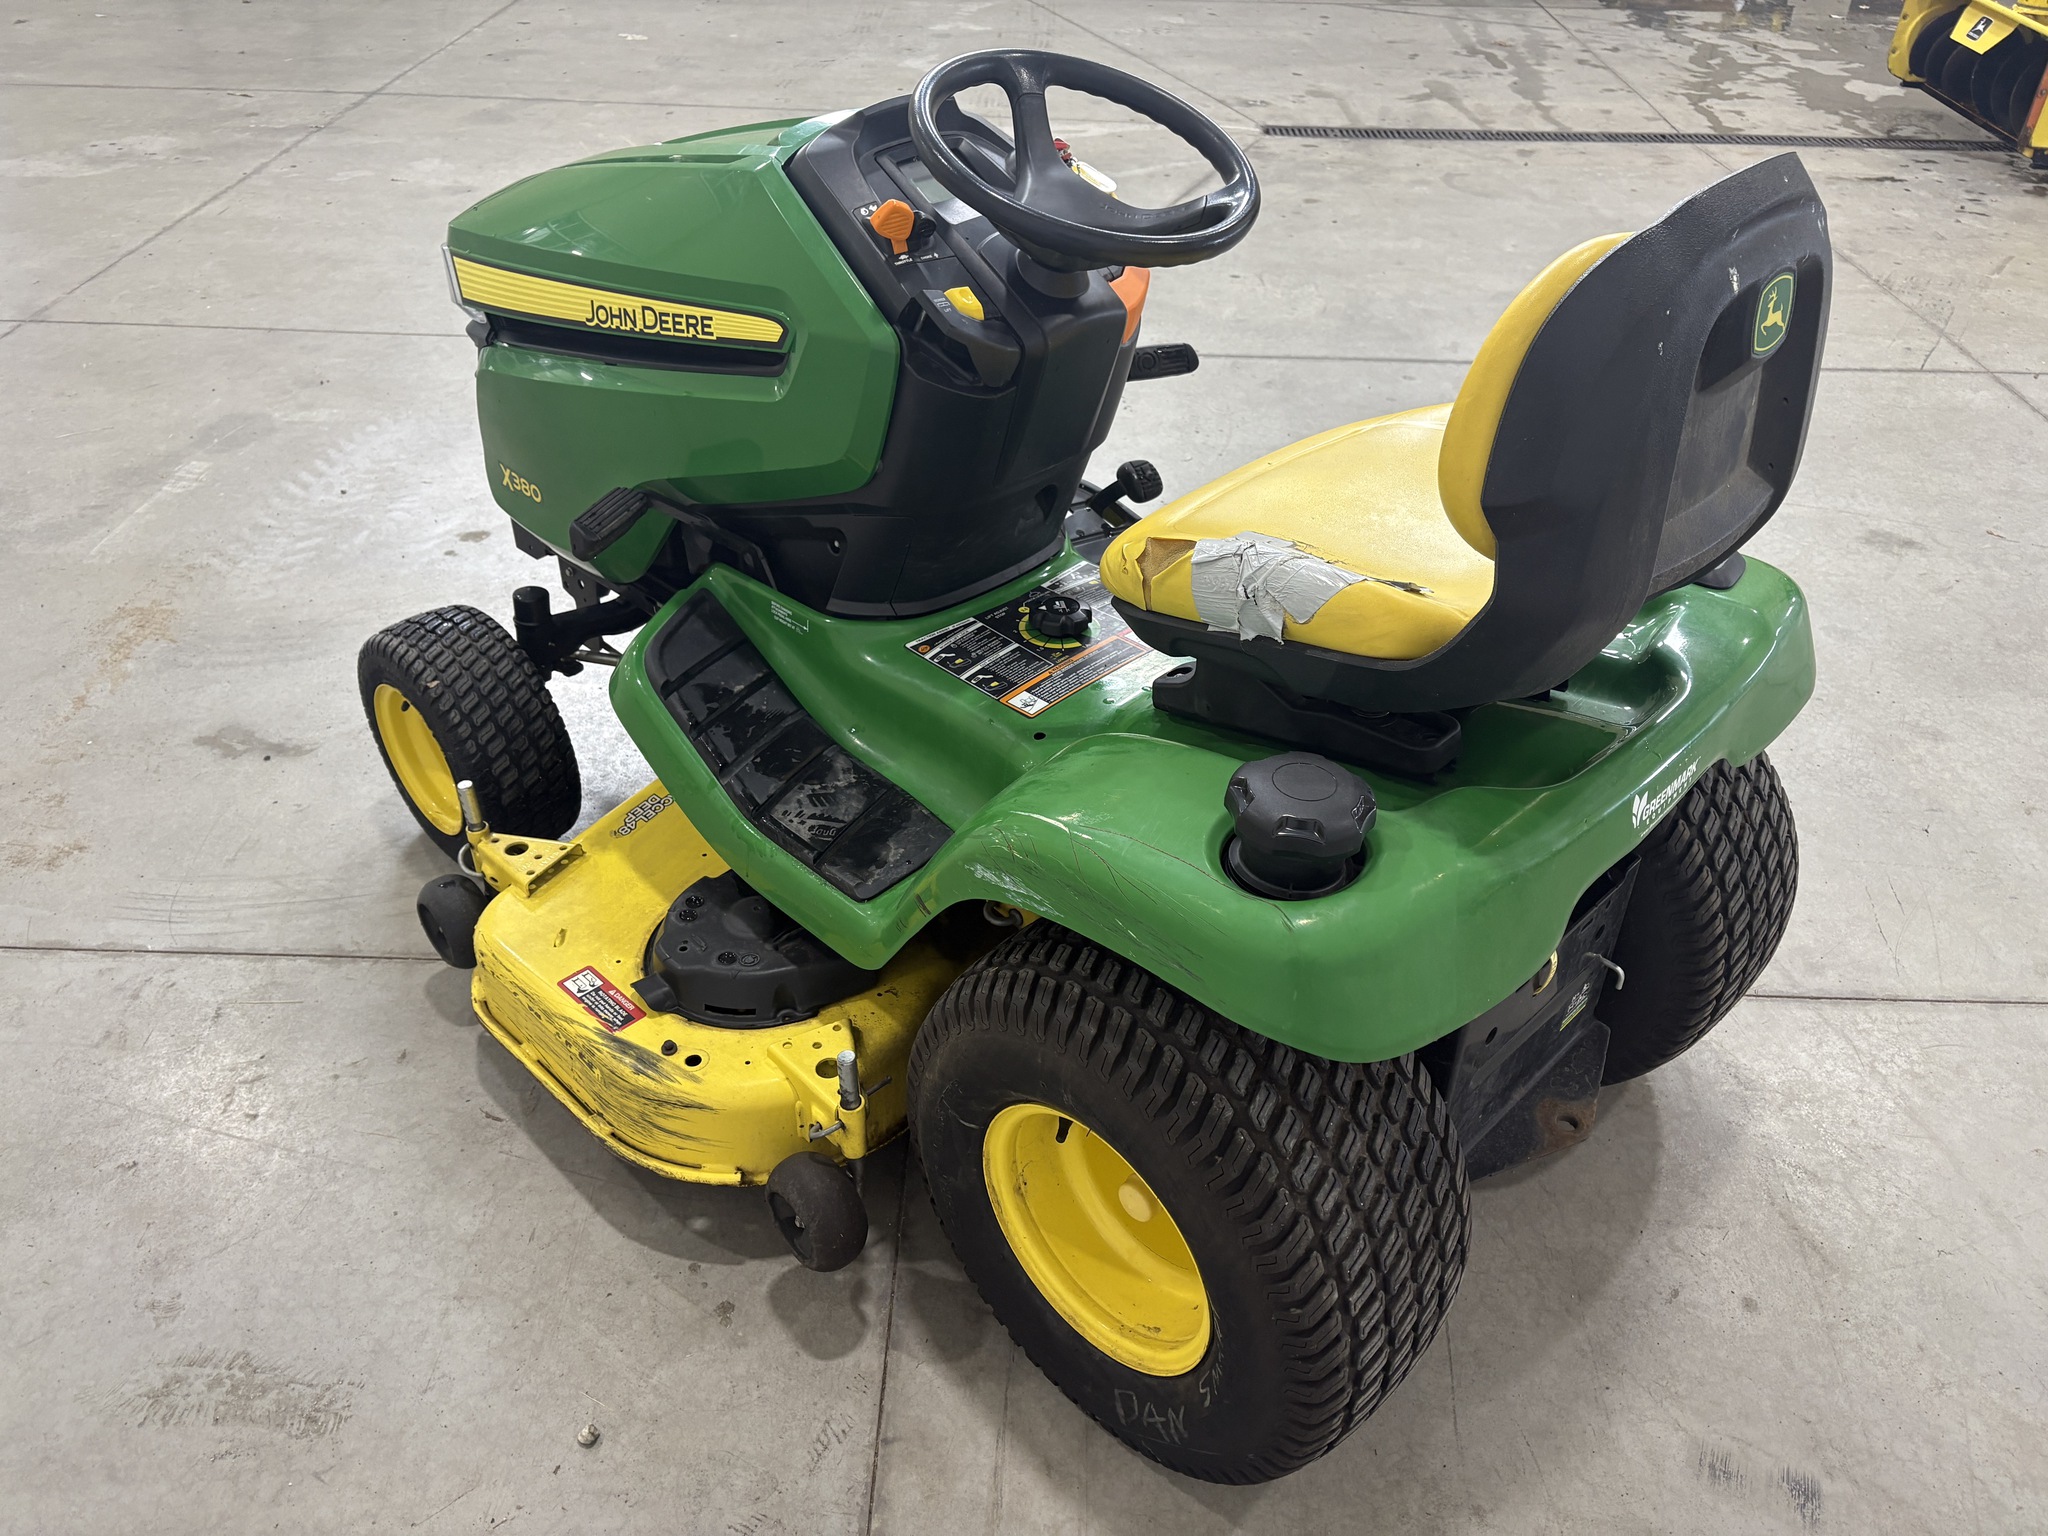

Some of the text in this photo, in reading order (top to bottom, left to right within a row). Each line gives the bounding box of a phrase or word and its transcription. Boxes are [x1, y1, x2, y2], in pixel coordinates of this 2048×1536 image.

[585, 300, 716, 339] JOHN DEERE
[498, 462, 542, 503] X380
[625, 794, 661, 823] DEEP
[1642, 756, 1702, 821] GREENMARK
[614, 992, 635, 1011] DANGER
[1114, 1388, 1188, 1445] DAN
